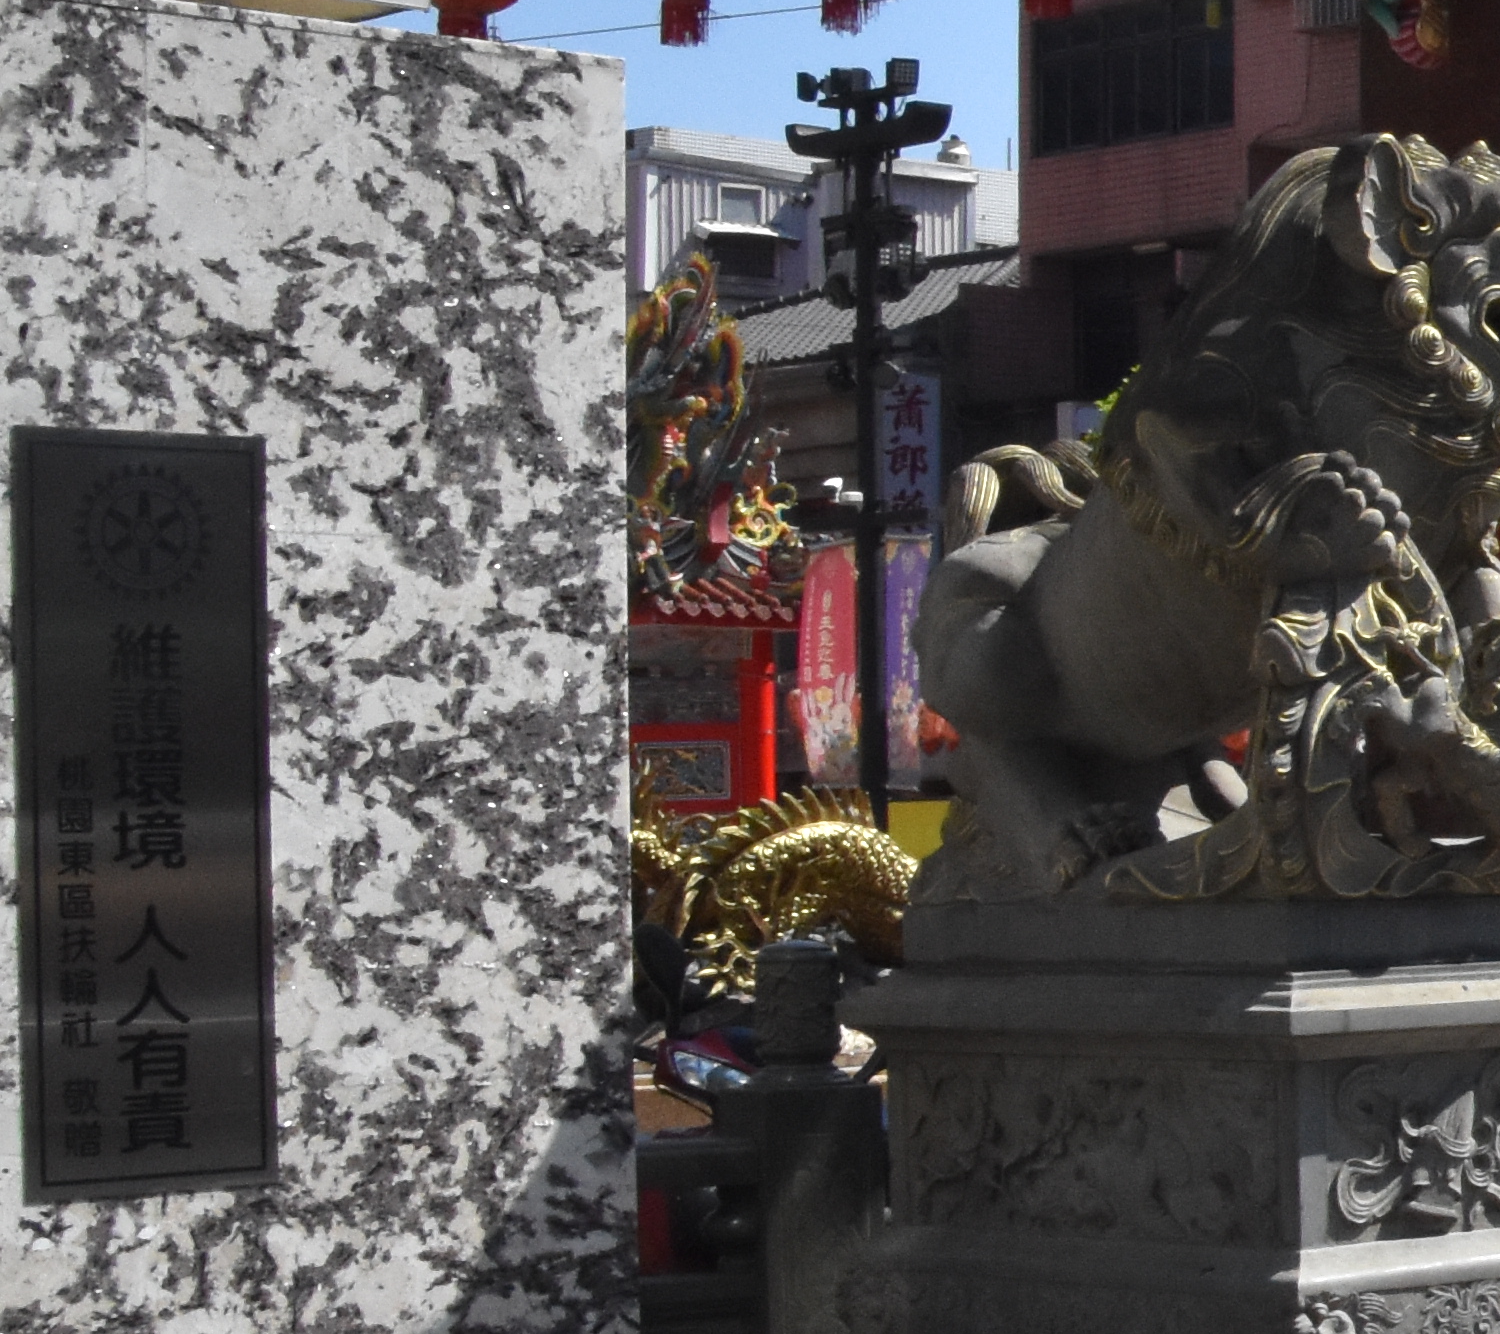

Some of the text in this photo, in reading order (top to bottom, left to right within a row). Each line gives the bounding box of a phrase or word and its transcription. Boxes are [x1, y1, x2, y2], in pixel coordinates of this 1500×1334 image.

[109, 622, 193, 1154] 維護環境 人人有責
